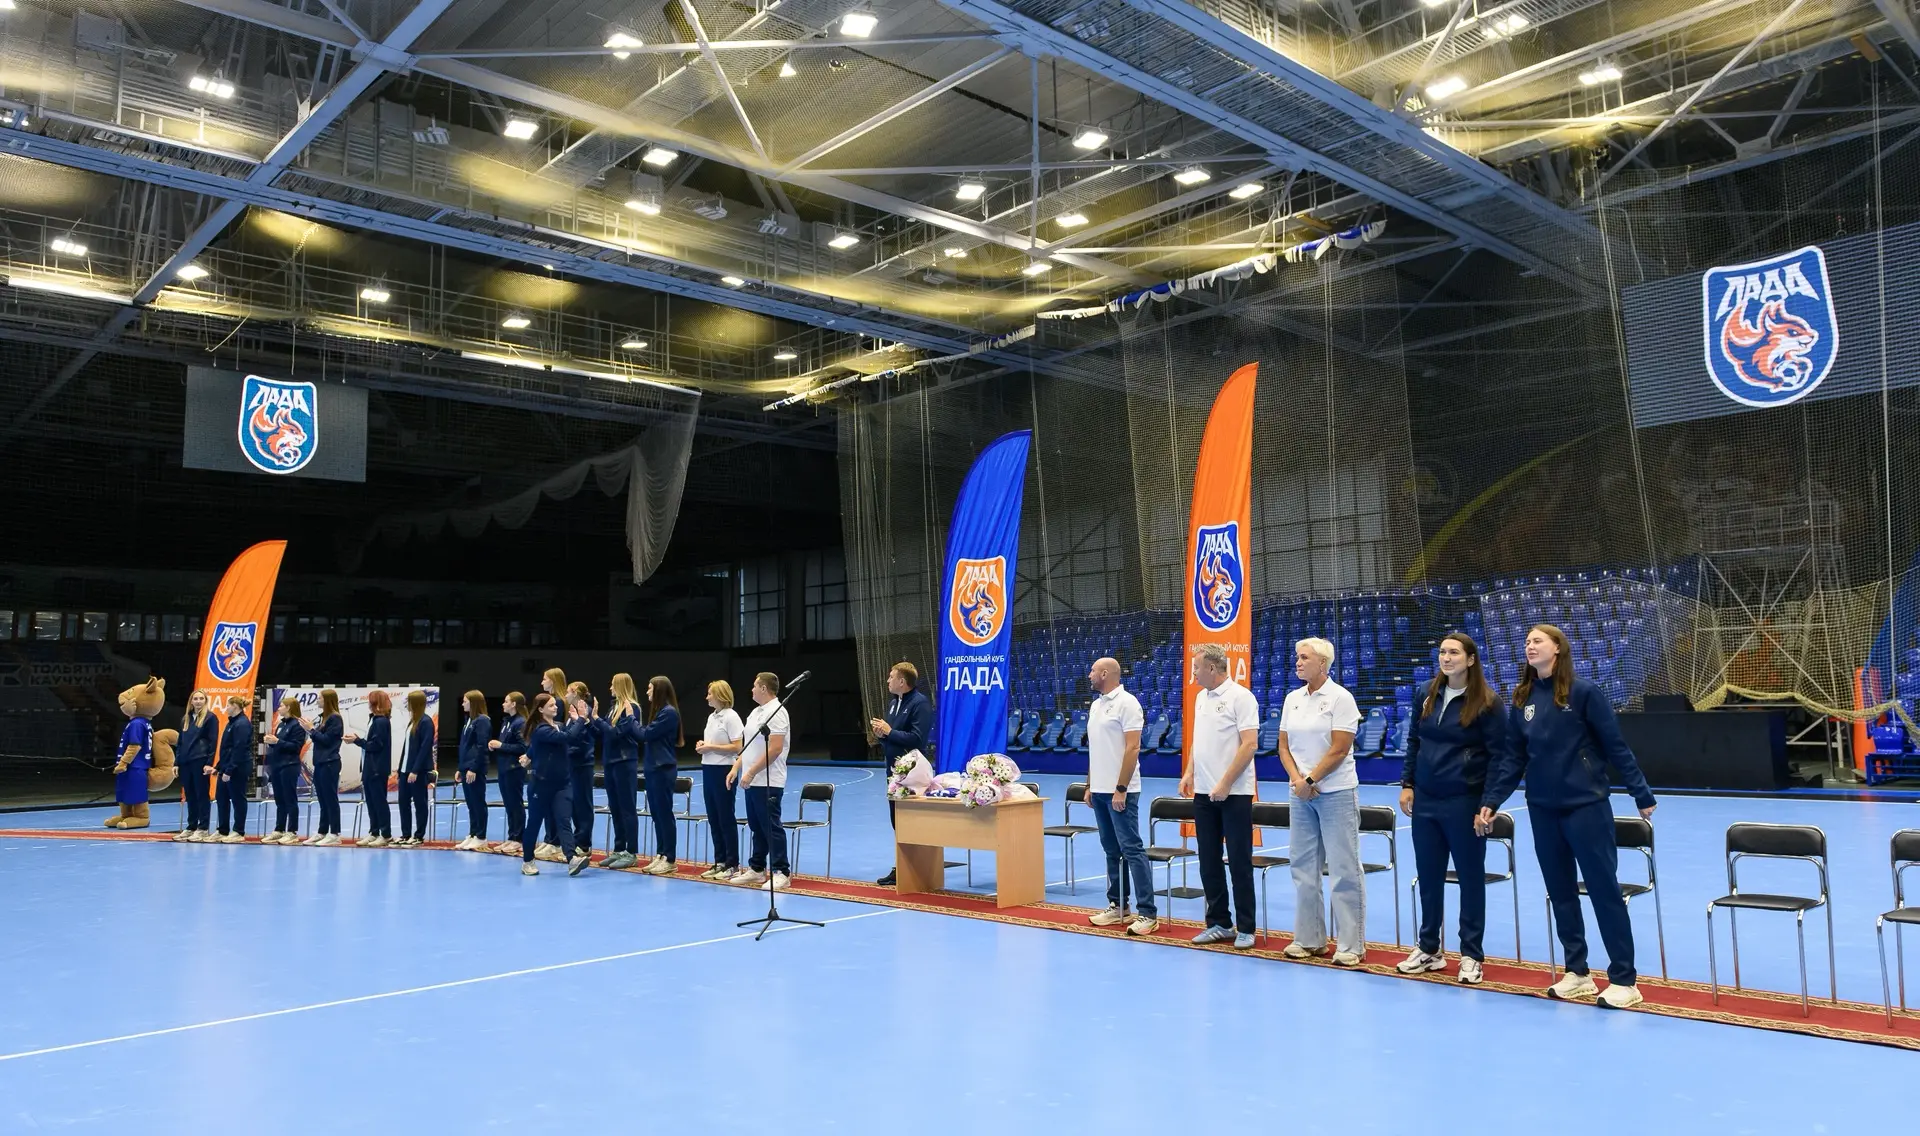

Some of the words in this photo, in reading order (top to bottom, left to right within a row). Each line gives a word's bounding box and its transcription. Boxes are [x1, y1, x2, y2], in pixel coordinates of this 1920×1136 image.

[1714, 261, 1820, 322] ЛАДА
[248, 384, 311, 417] ЛАДА
[1232, 643, 1250, 653] КЛУБ
[944, 654, 991, 664] ГАНДБОЛЬНЫЙ
[991, 654, 1005, 663] КЛУБ
[33, 664, 112, 674] ТОЛЬЯТТИ
[30, 675, 93, 685] КАУЧУК
[944, 666, 1005, 694] ЛАДА
